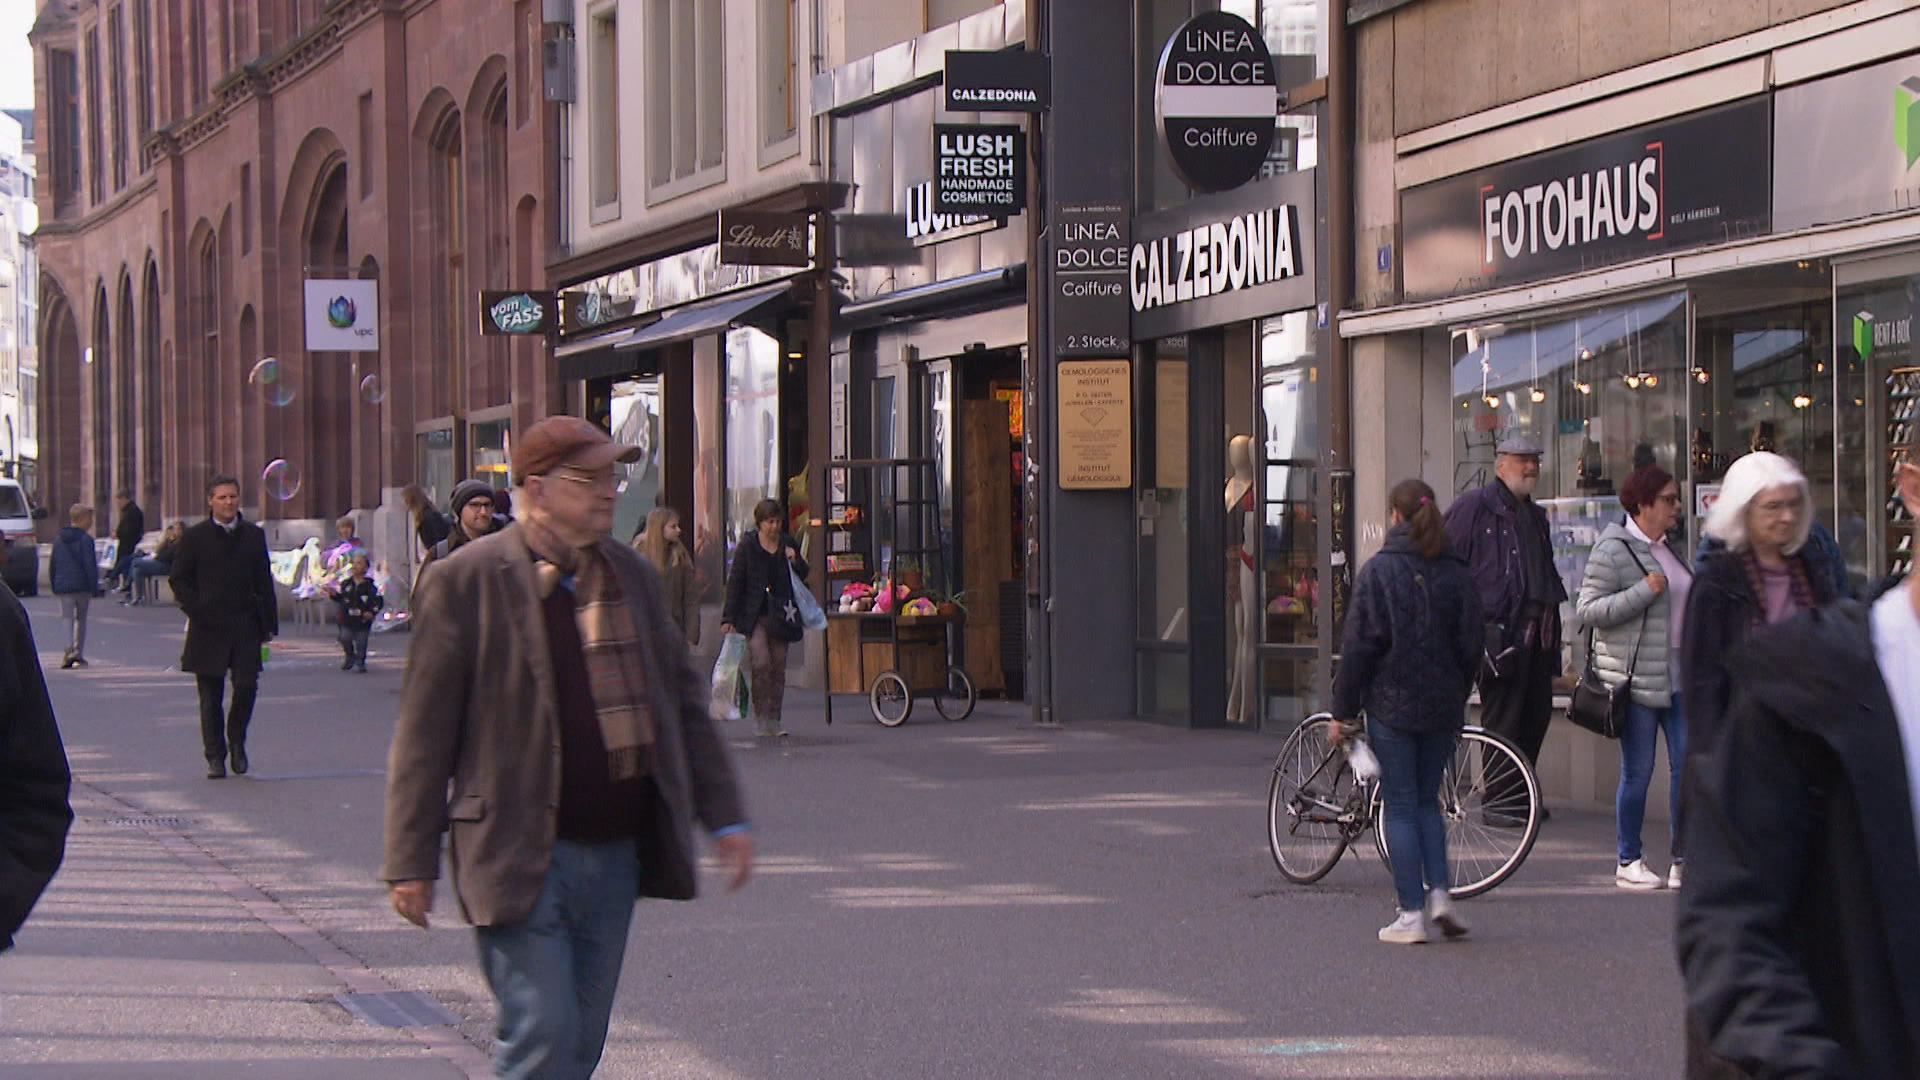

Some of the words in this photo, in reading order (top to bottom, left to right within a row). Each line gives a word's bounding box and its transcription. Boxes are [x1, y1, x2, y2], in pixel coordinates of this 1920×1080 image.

[1176, 62, 1265, 84] DOLCE
[952, 88, 1037, 102] CALZEDONIA
[940, 135, 1014, 156] LUSH
[1184, 128, 1258, 147] Coiffure
[940, 157, 1014, 177] FRESH
[941, 179, 1014, 190] HANDMADE
[941, 191, 1014, 204] COSMETICS
[1485, 156, 1659, 264] FOTOHAUS
[724, 225, 787, 248] Lindt
[1057, 247, 1128, 267] DOLCE
[1130, 203, 1295, 312] CALZEDONIA
[1062, 281, 1122, 296] Coiffure
[490, 301, 519, 317] vom
[502, 305, 543, 329] FASS
[1067, 336, 1079, 348] 2.
[1081, 335, 1118, 348] Stock
